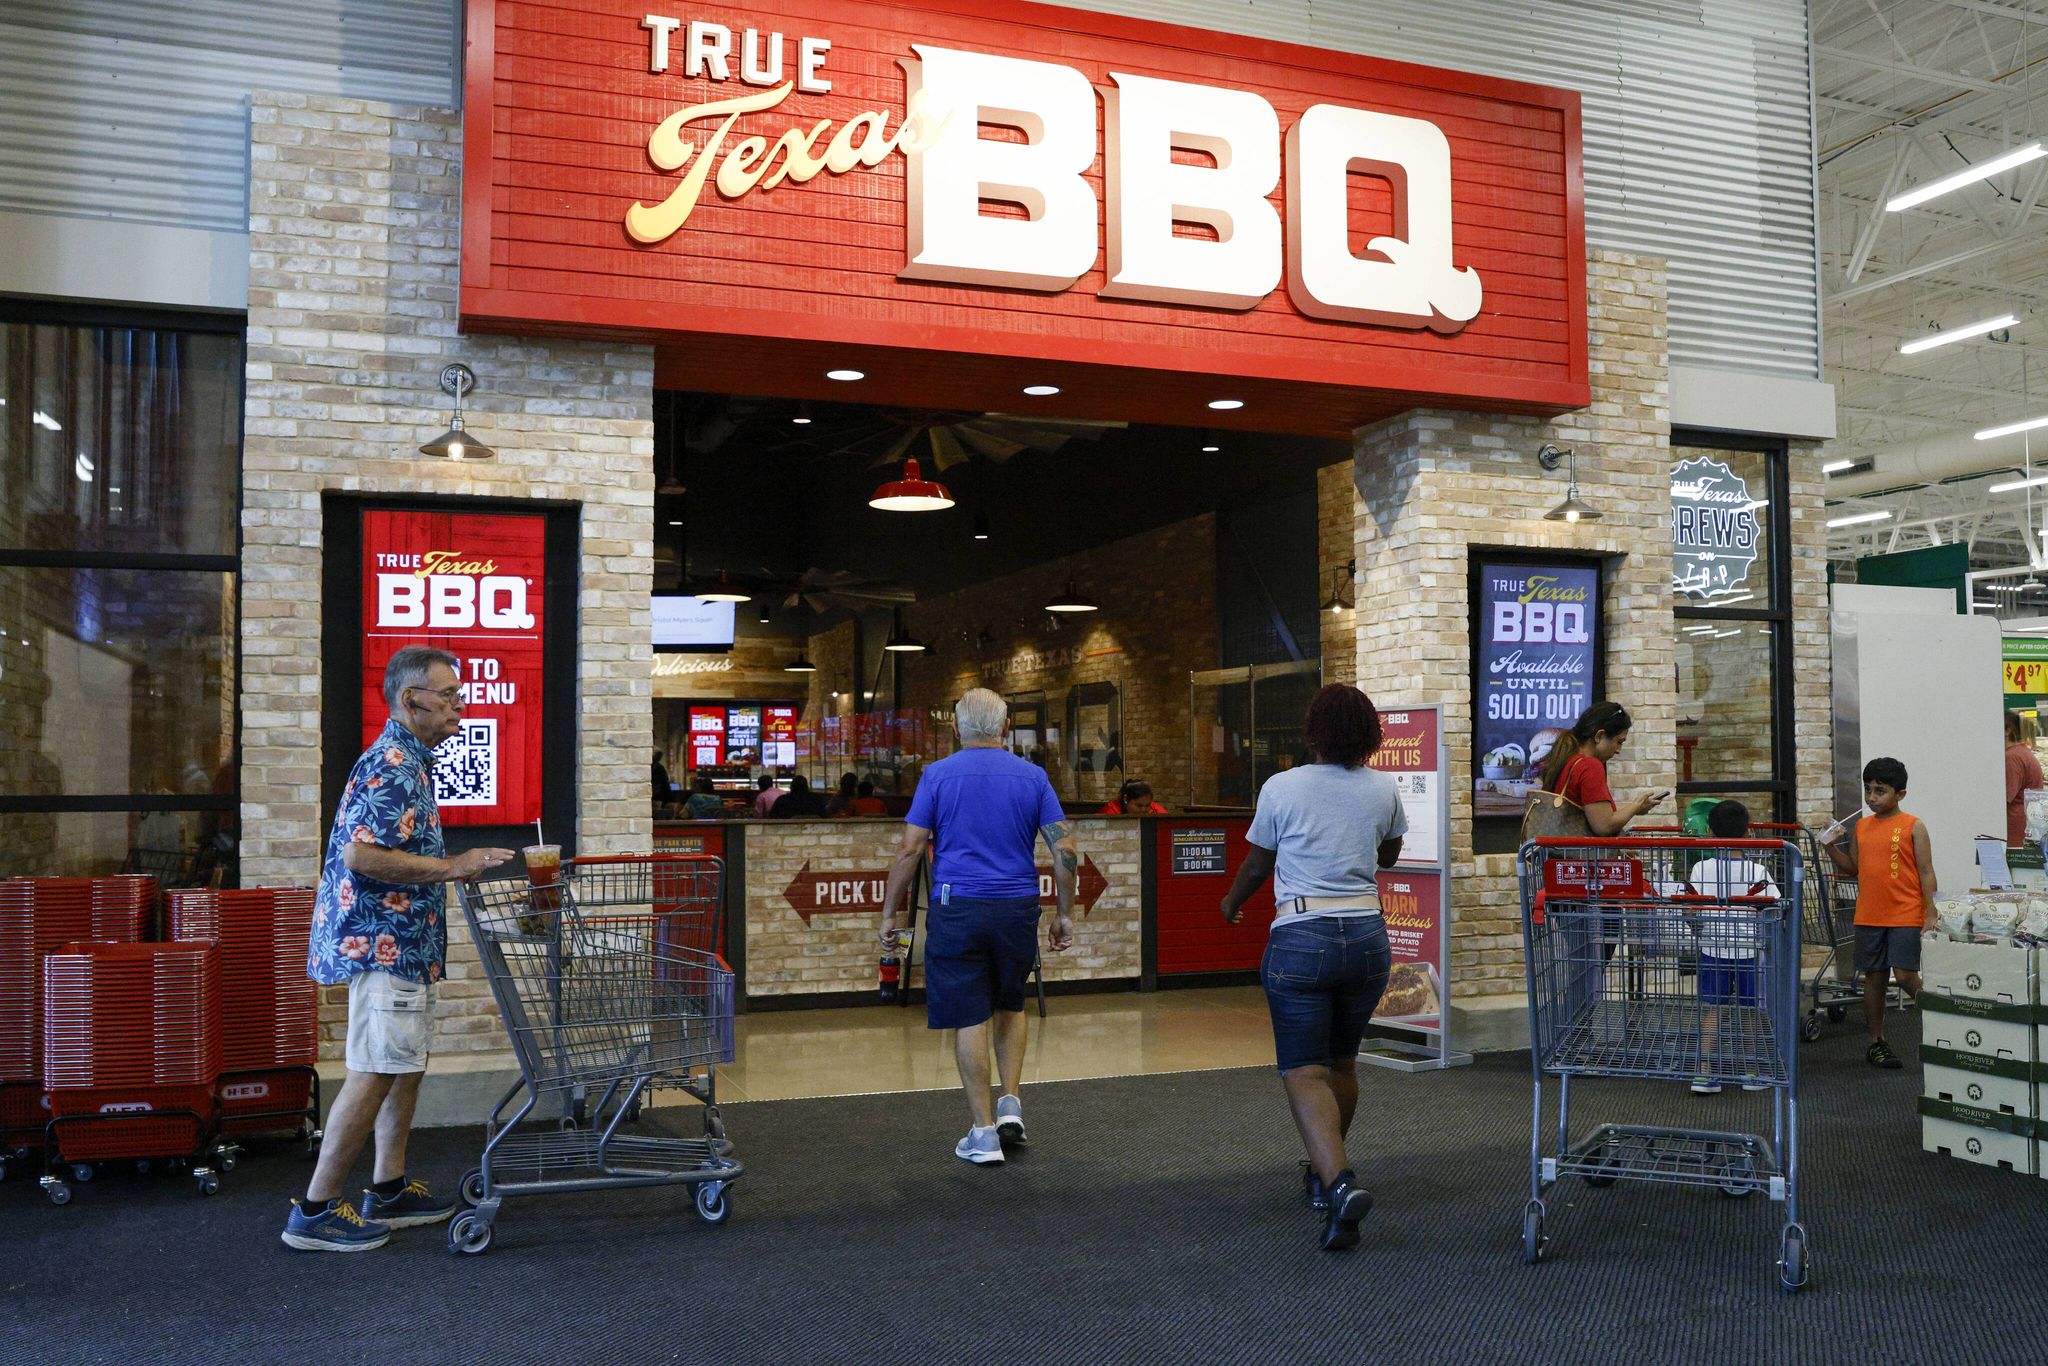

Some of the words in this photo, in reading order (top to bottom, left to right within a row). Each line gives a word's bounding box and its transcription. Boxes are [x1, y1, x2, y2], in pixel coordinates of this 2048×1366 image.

[641, 14, 831, 94] TRUE
[625, 79, 955, 244] Texas
[897, 43, 1483, 334] BBQ
[1692, 476, 1745, 503] Texas
[377, 553, 421, 568] TRUE
[414, 551, 498, 579] Texas
[1493, 579, 1525, 592] TRUE
[1518, 575, 1588, 604] Texas
[376, 573, 535, 629] BBQ
[1492, 601, 1588, 643] BBQ
[468, 658, 499, 680] TO
[1490, 649, 1585, 674] Available
[1506, 678, 1568, 690] UNTIL
[1488, 693, 1538, 720] SOLD
[1545, 694, 1583, 720] OUT
[1388, 713, 1409, 724] BBQ
[1404, 750, 1421, 766] US
[1182, 847, 1201, 856] 11:00
[1201, 847, 1212, 856] AM
[1201, 860, 1212, 869] PM
[815, 880, 865, 904] PICK
[871, 879, 885, 903] U
[1393, 883, 1411, 893] BBQ
[1382, 893, 1418, 914] DARN
[1383, 909, 1434, 929] elicious
[1397, 937, 1420, 946] POTATO
[1400, 930, 1424, 939] BRISKET
[1952, 1105, 1971, 1116] HOOD
[1970, 1109, 1991, 1120] RIVER
